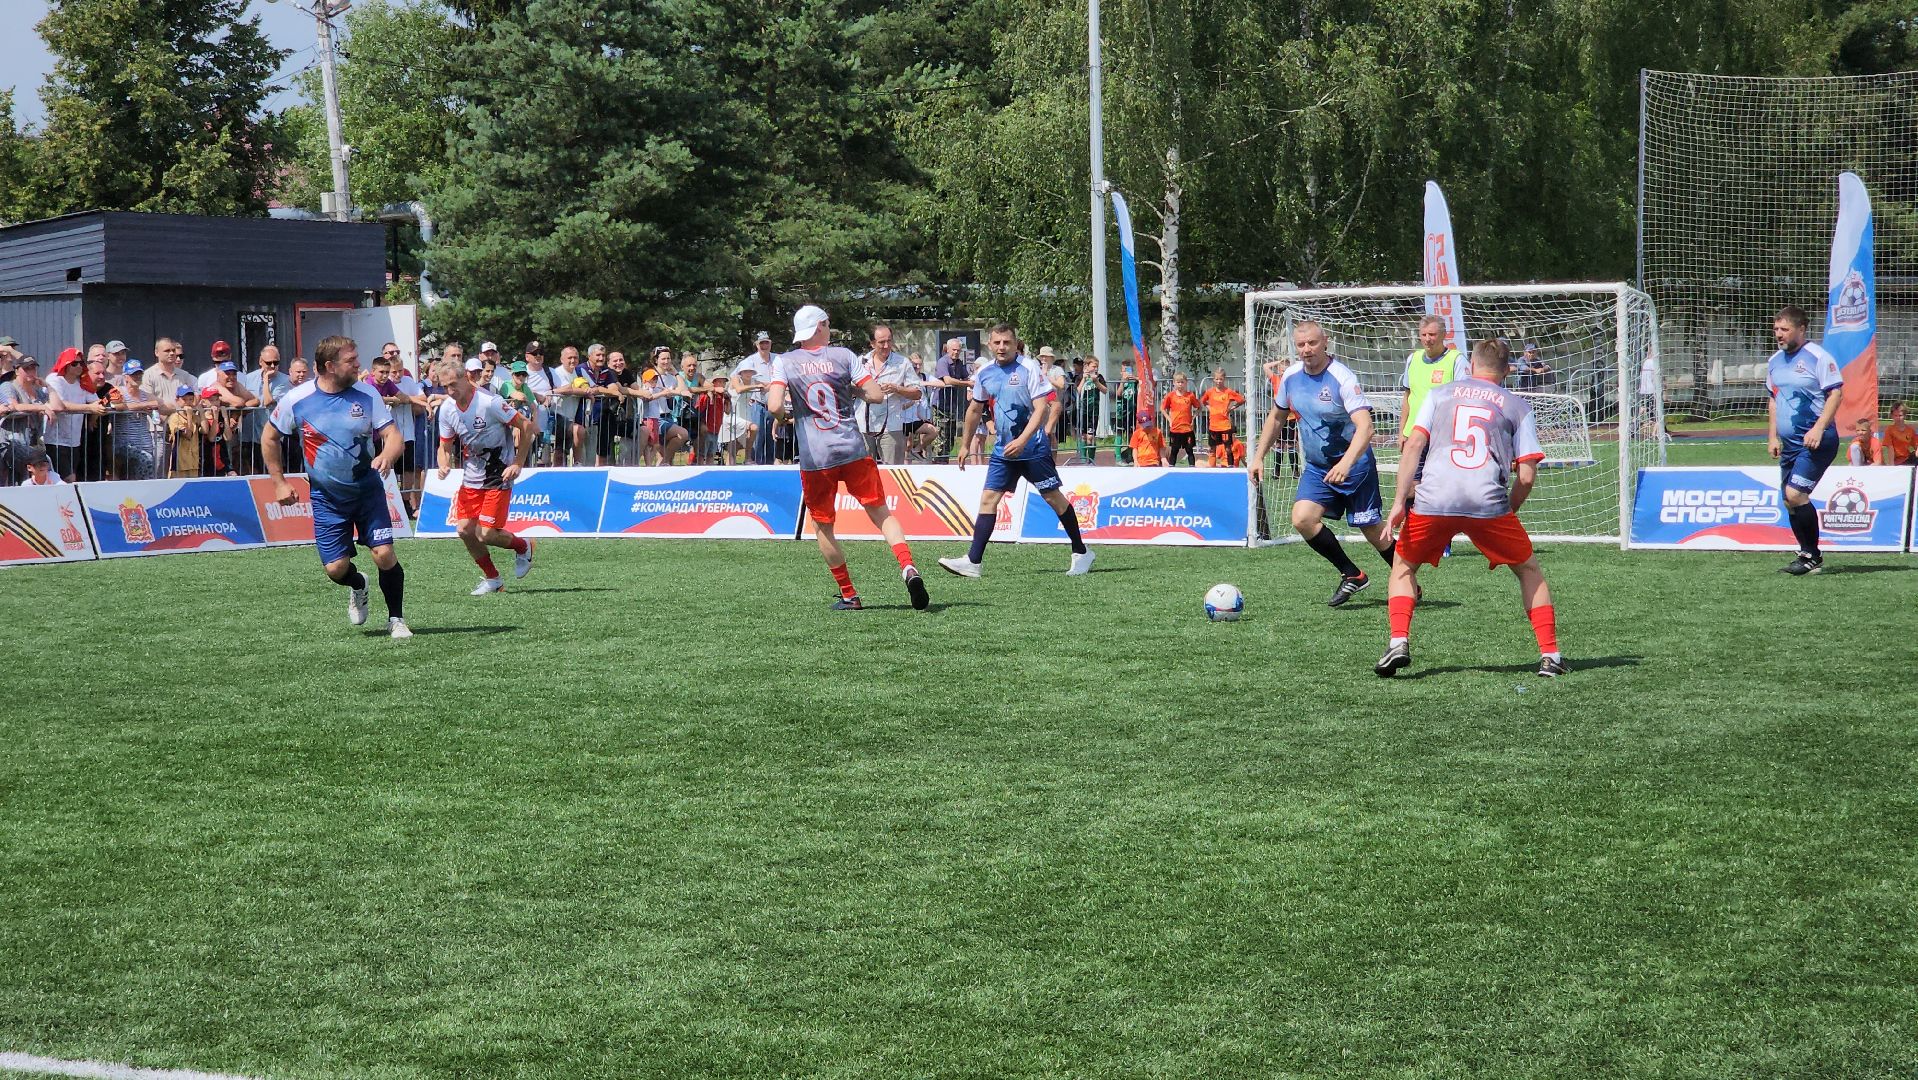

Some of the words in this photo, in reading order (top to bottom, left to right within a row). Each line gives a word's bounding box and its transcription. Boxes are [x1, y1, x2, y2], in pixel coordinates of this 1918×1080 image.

[801, 361, 834, 376] ТИТОВ
[1453, 386, 1505, 408] КАРЯКА
[806, 381, 840, 431] 9
[1451, 404, 1493, 470] 5
[510, 494, 551, 507] МАНДА
[633, 490, 733, 502] #ВЫХОДИВОДВОР
[1110, 496, 1186, 511] КОМАНДА
[1661, 489, 1779, 506] МОСОБЛ
[155, 505, 212, 519] КОМАНДА
[630, 502, 770, 515] #КОМАНДАГУБЕРНАТОРА
[1659, 506, 1762, 524] СПОРТ
[507, 511, 571, 522] ЕРНАТОРА
[1108, 514, 1213, 528] ГУБЕРНАТОРА
[161, 522, 238, 537] ГУБЕРНАТОРА
